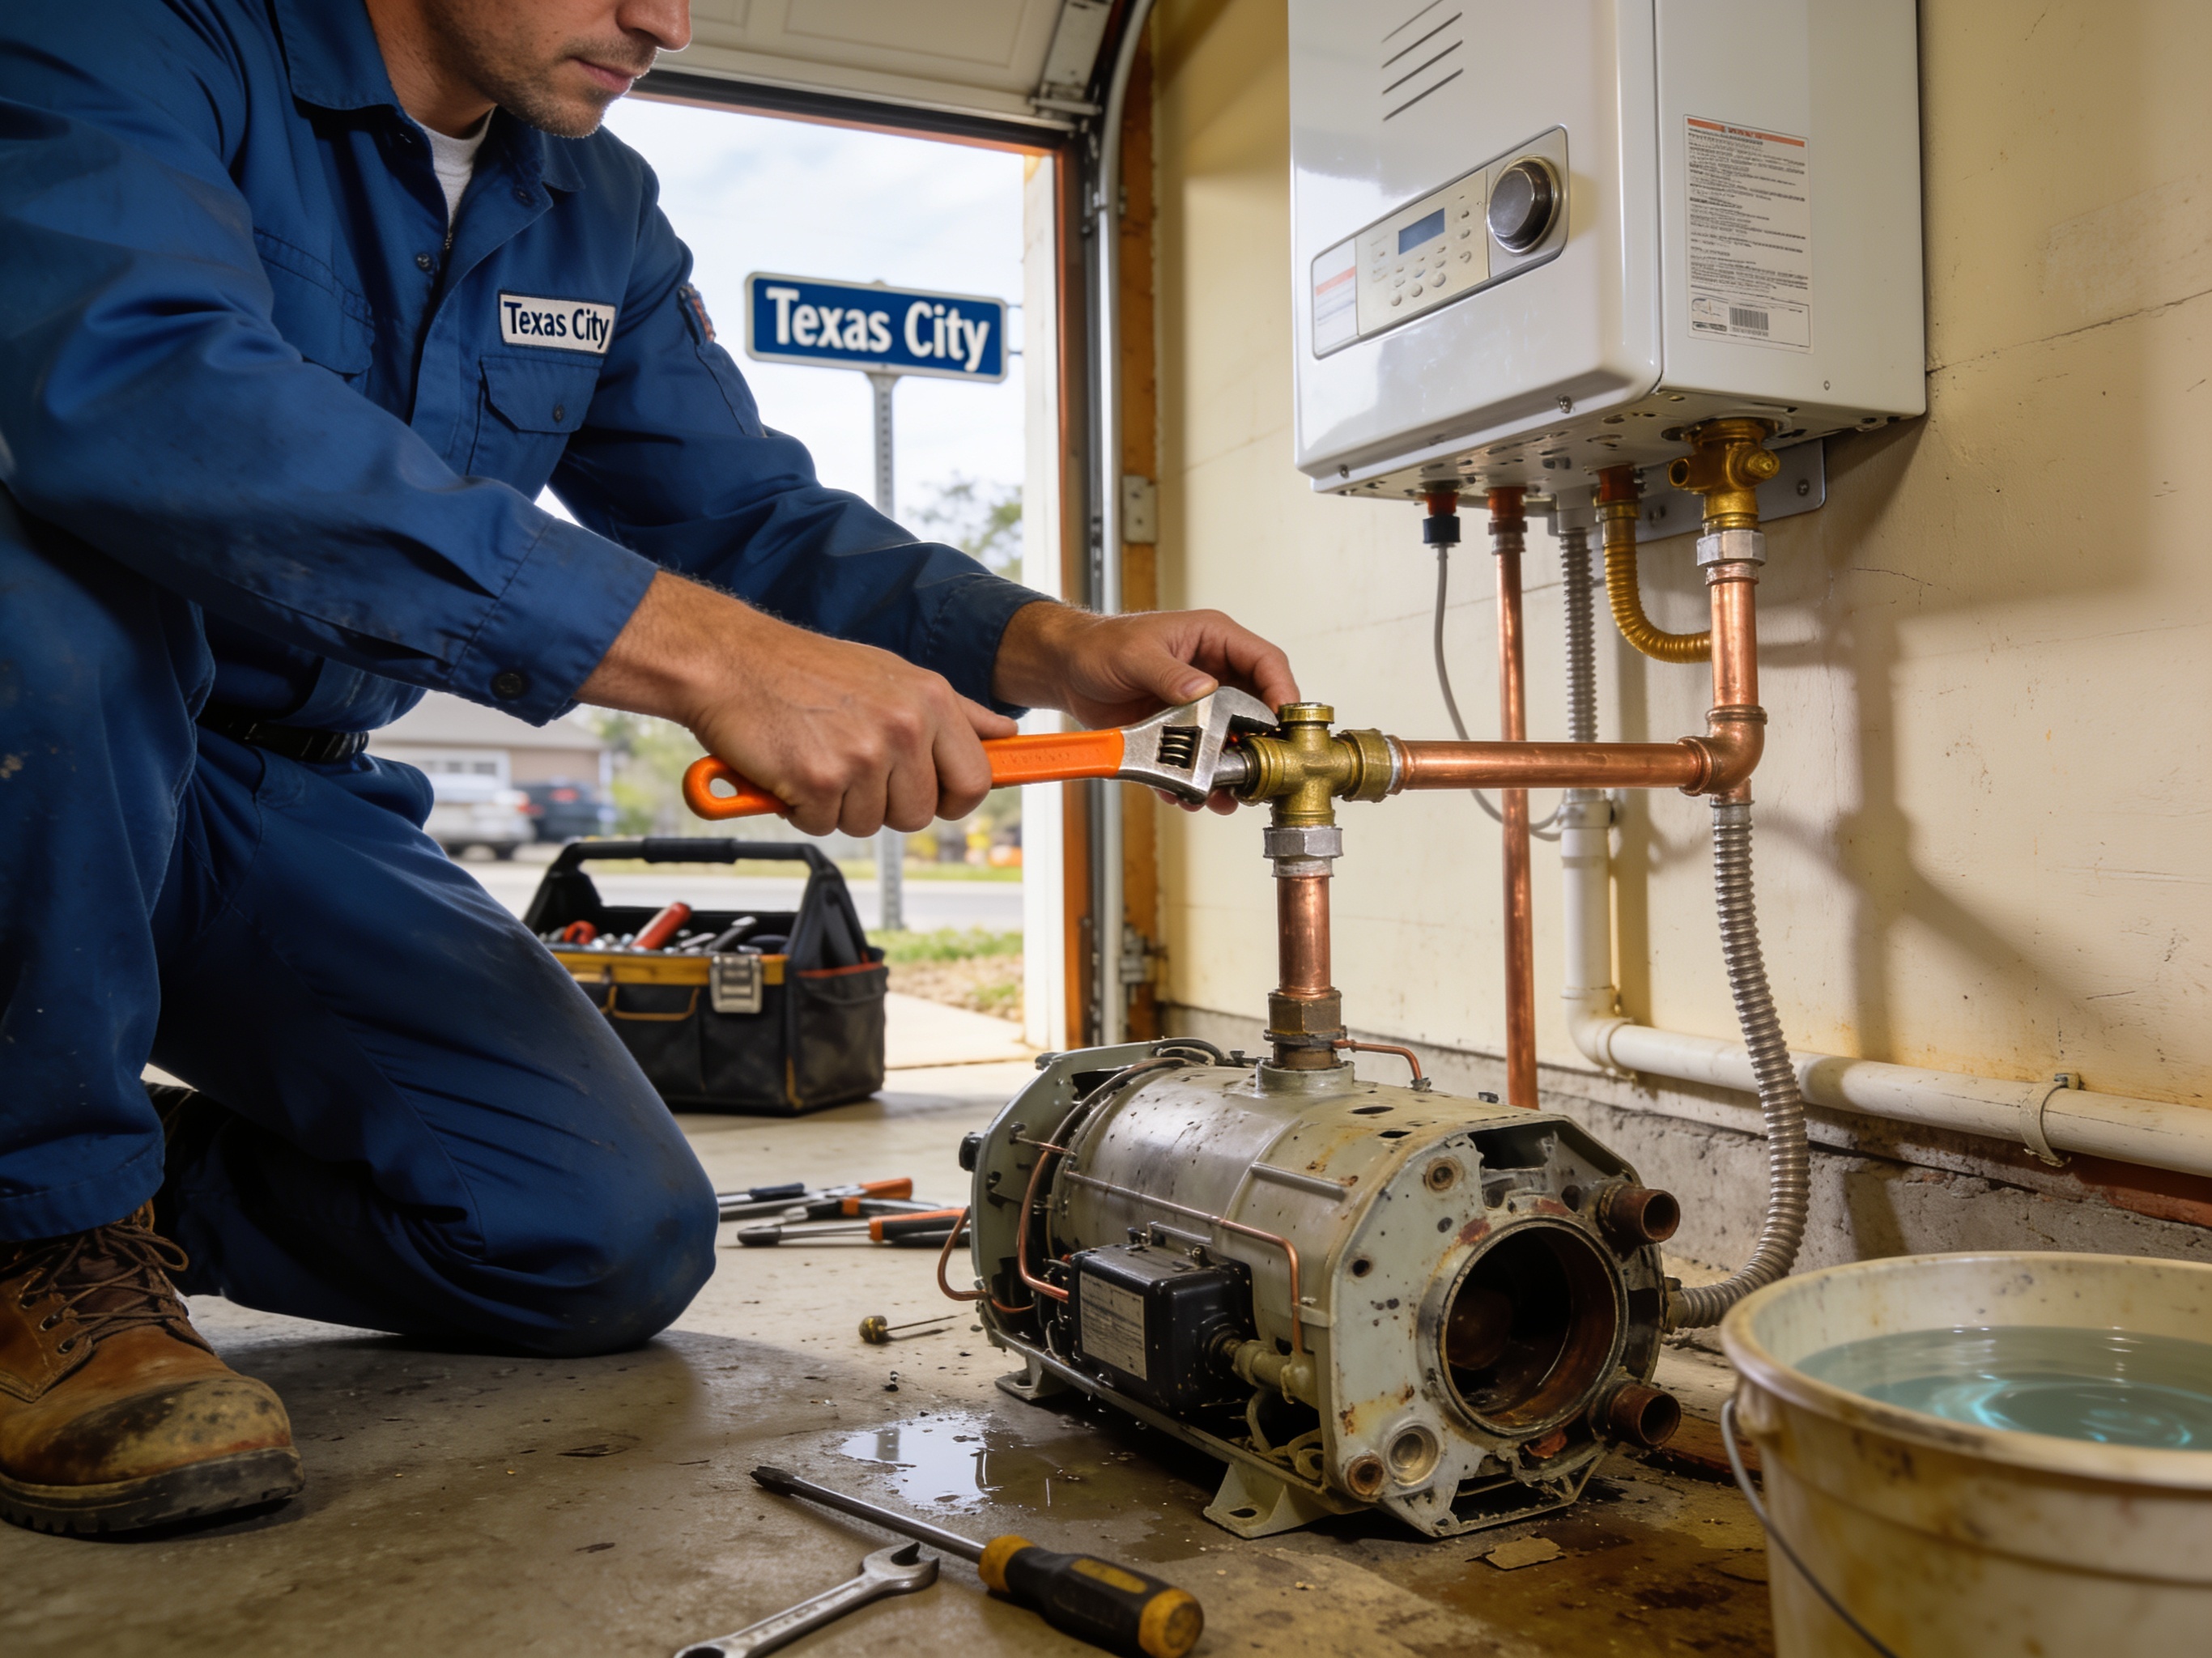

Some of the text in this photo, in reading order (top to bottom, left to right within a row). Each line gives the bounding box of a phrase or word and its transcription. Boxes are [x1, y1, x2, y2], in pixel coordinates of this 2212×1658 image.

[504, 301, 609, 350] Texas City
[766, 287, 989, 372] Texas City
